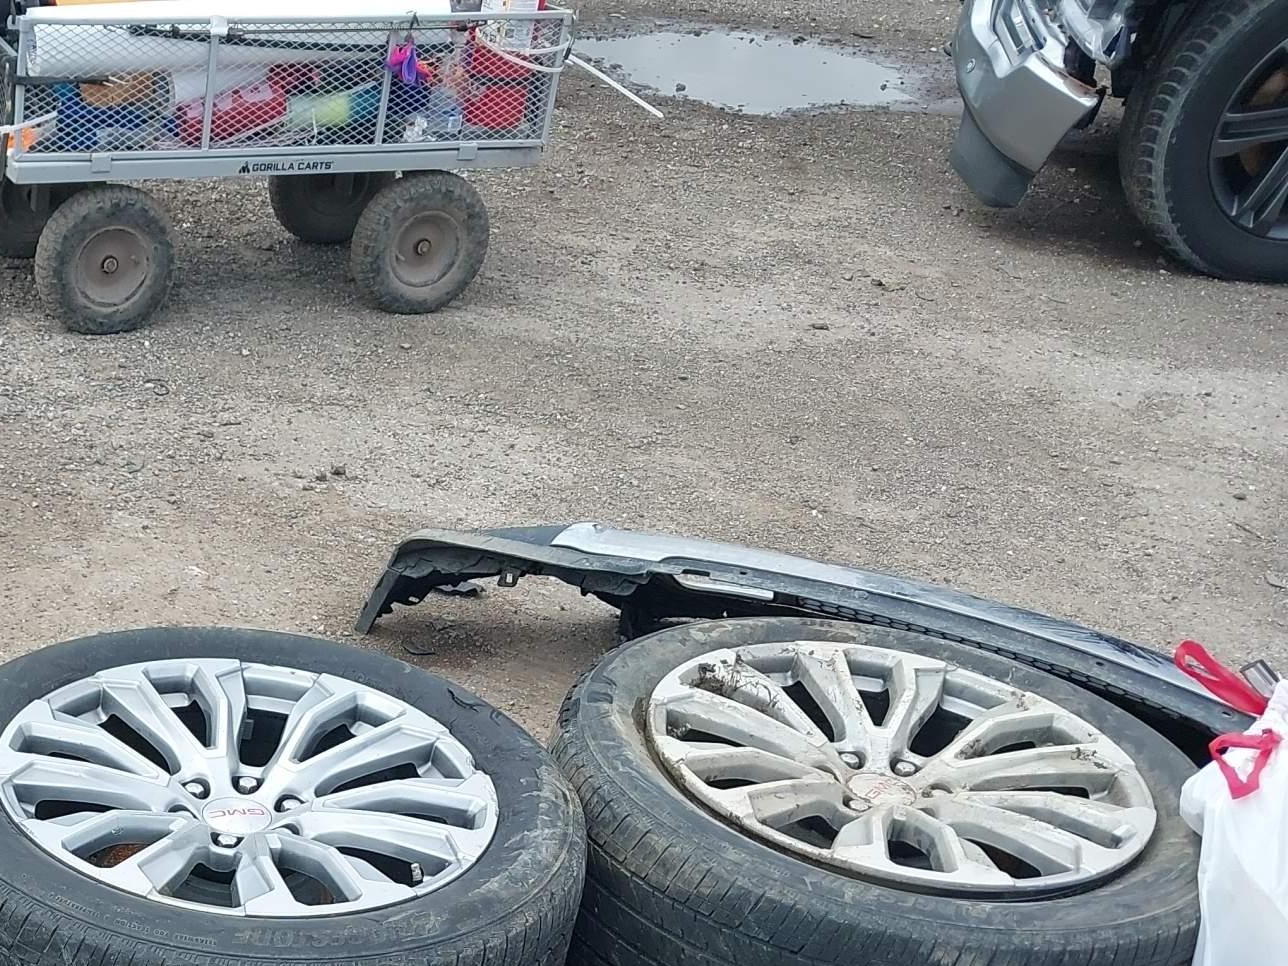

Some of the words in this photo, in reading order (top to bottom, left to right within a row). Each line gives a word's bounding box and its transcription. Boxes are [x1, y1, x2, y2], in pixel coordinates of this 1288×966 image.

[252, 162, 295, 172] GORILLA
[297, 161, 332, 171] CARTS
[210, 808, 265, 818] GMC
